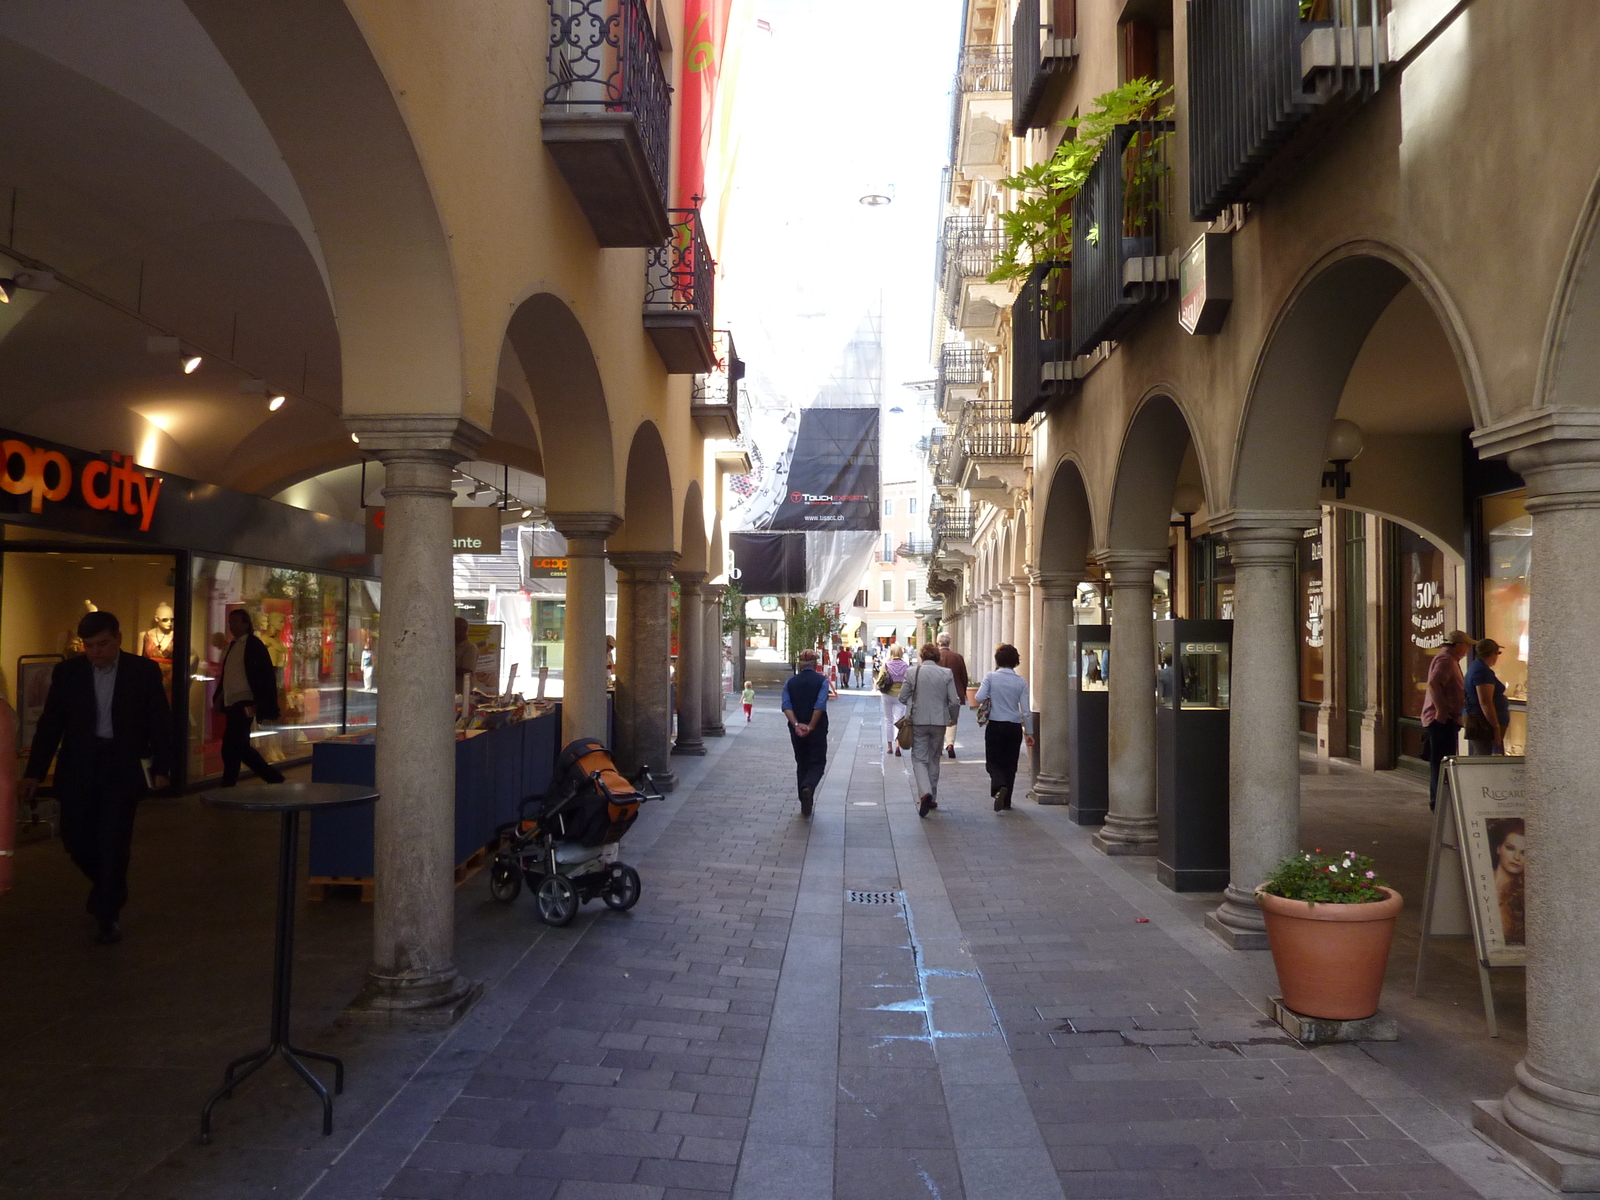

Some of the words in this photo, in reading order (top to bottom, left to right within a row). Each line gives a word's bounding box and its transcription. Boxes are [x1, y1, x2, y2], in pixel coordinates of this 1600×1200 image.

[81, 450, 163, 531] city
[533, 558, 568, 571] coop
[1416, 581, 1440, 609] 50%
[1411, 614, 1421, 628] sui
[1421, 610, 1443, 632] gioielli
[1185, 643, 1222, 652] EBEL
